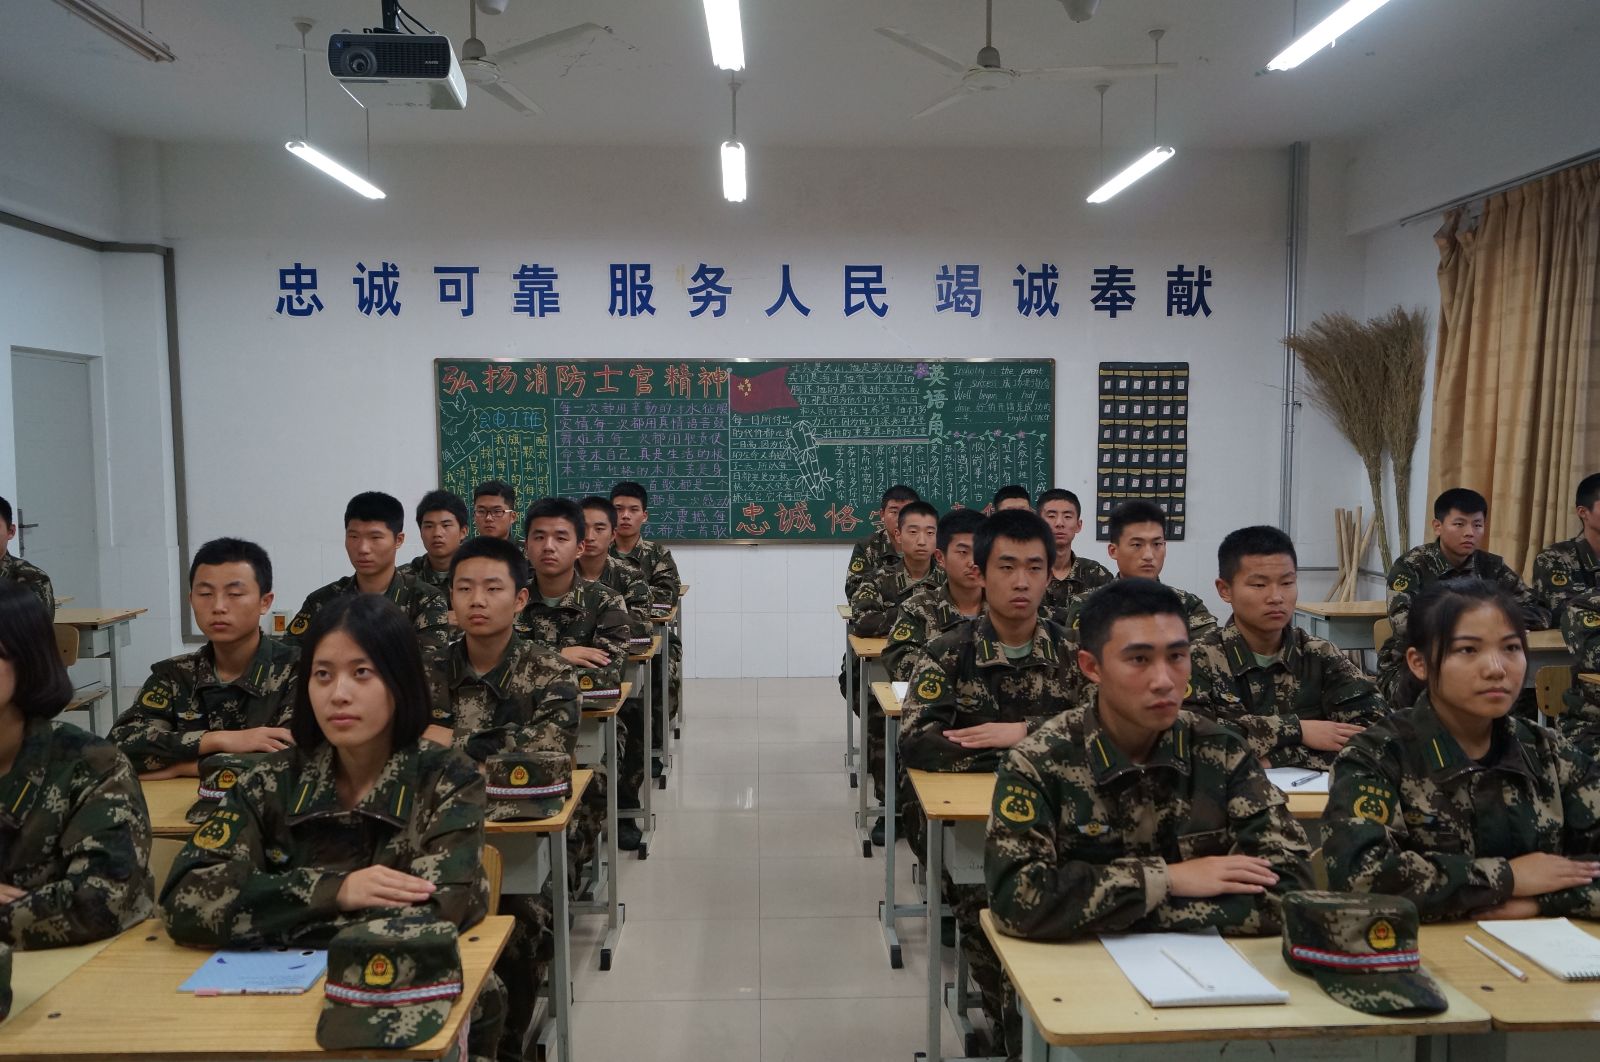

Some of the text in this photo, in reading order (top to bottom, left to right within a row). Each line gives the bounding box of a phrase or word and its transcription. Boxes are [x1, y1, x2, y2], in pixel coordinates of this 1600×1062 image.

[275, 262, 1214, 318] 忠诚可靠 服务人民 竭诚奉献
[441, 364, 729, 400] 弘扬消防士官精神
[1001, 366, 1015, 376] the
[924, 364, 952, 438] 英语角
[954, 390, 972, 400] Well
[1007, 413, 1028, 427] English
